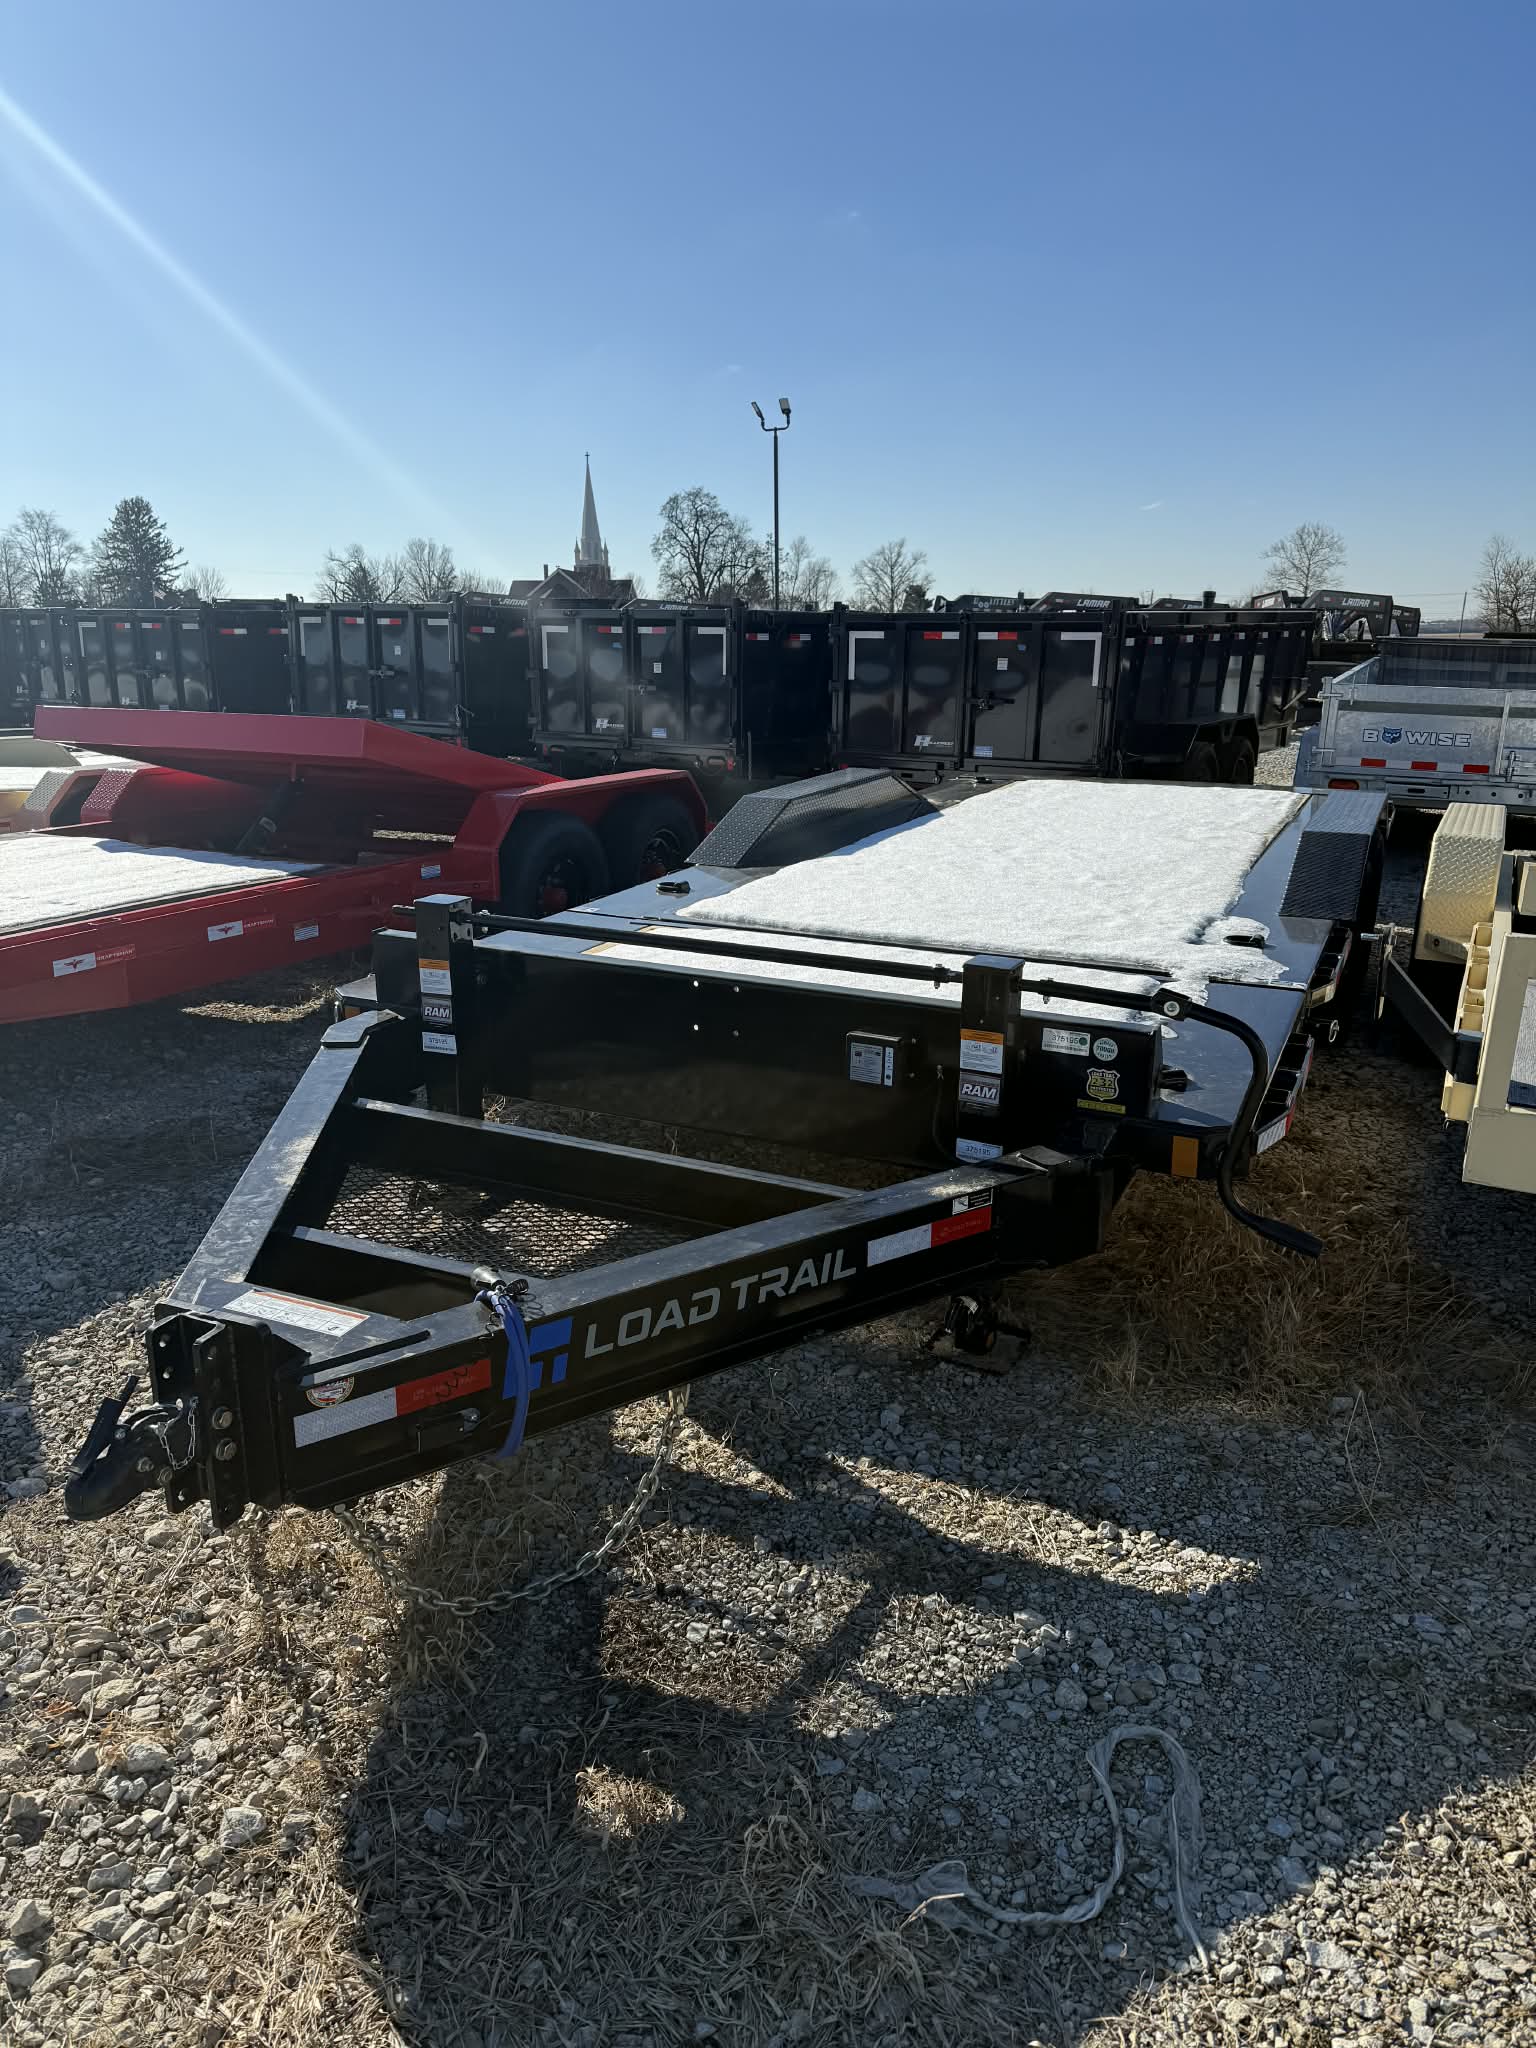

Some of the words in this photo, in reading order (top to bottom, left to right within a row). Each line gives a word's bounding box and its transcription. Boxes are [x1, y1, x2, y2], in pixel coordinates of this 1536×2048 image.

[1076, 599, 1111, 609] LAMAR
[1342, 598, 1371, 608] LAMAR
[424, 1005, 450, 1019] RAM
[961, 1083, 998, 1099] RAM
[584, 1286, 721, 1360] LOAD
[730, 1248, 857, 1311] TRAIL
